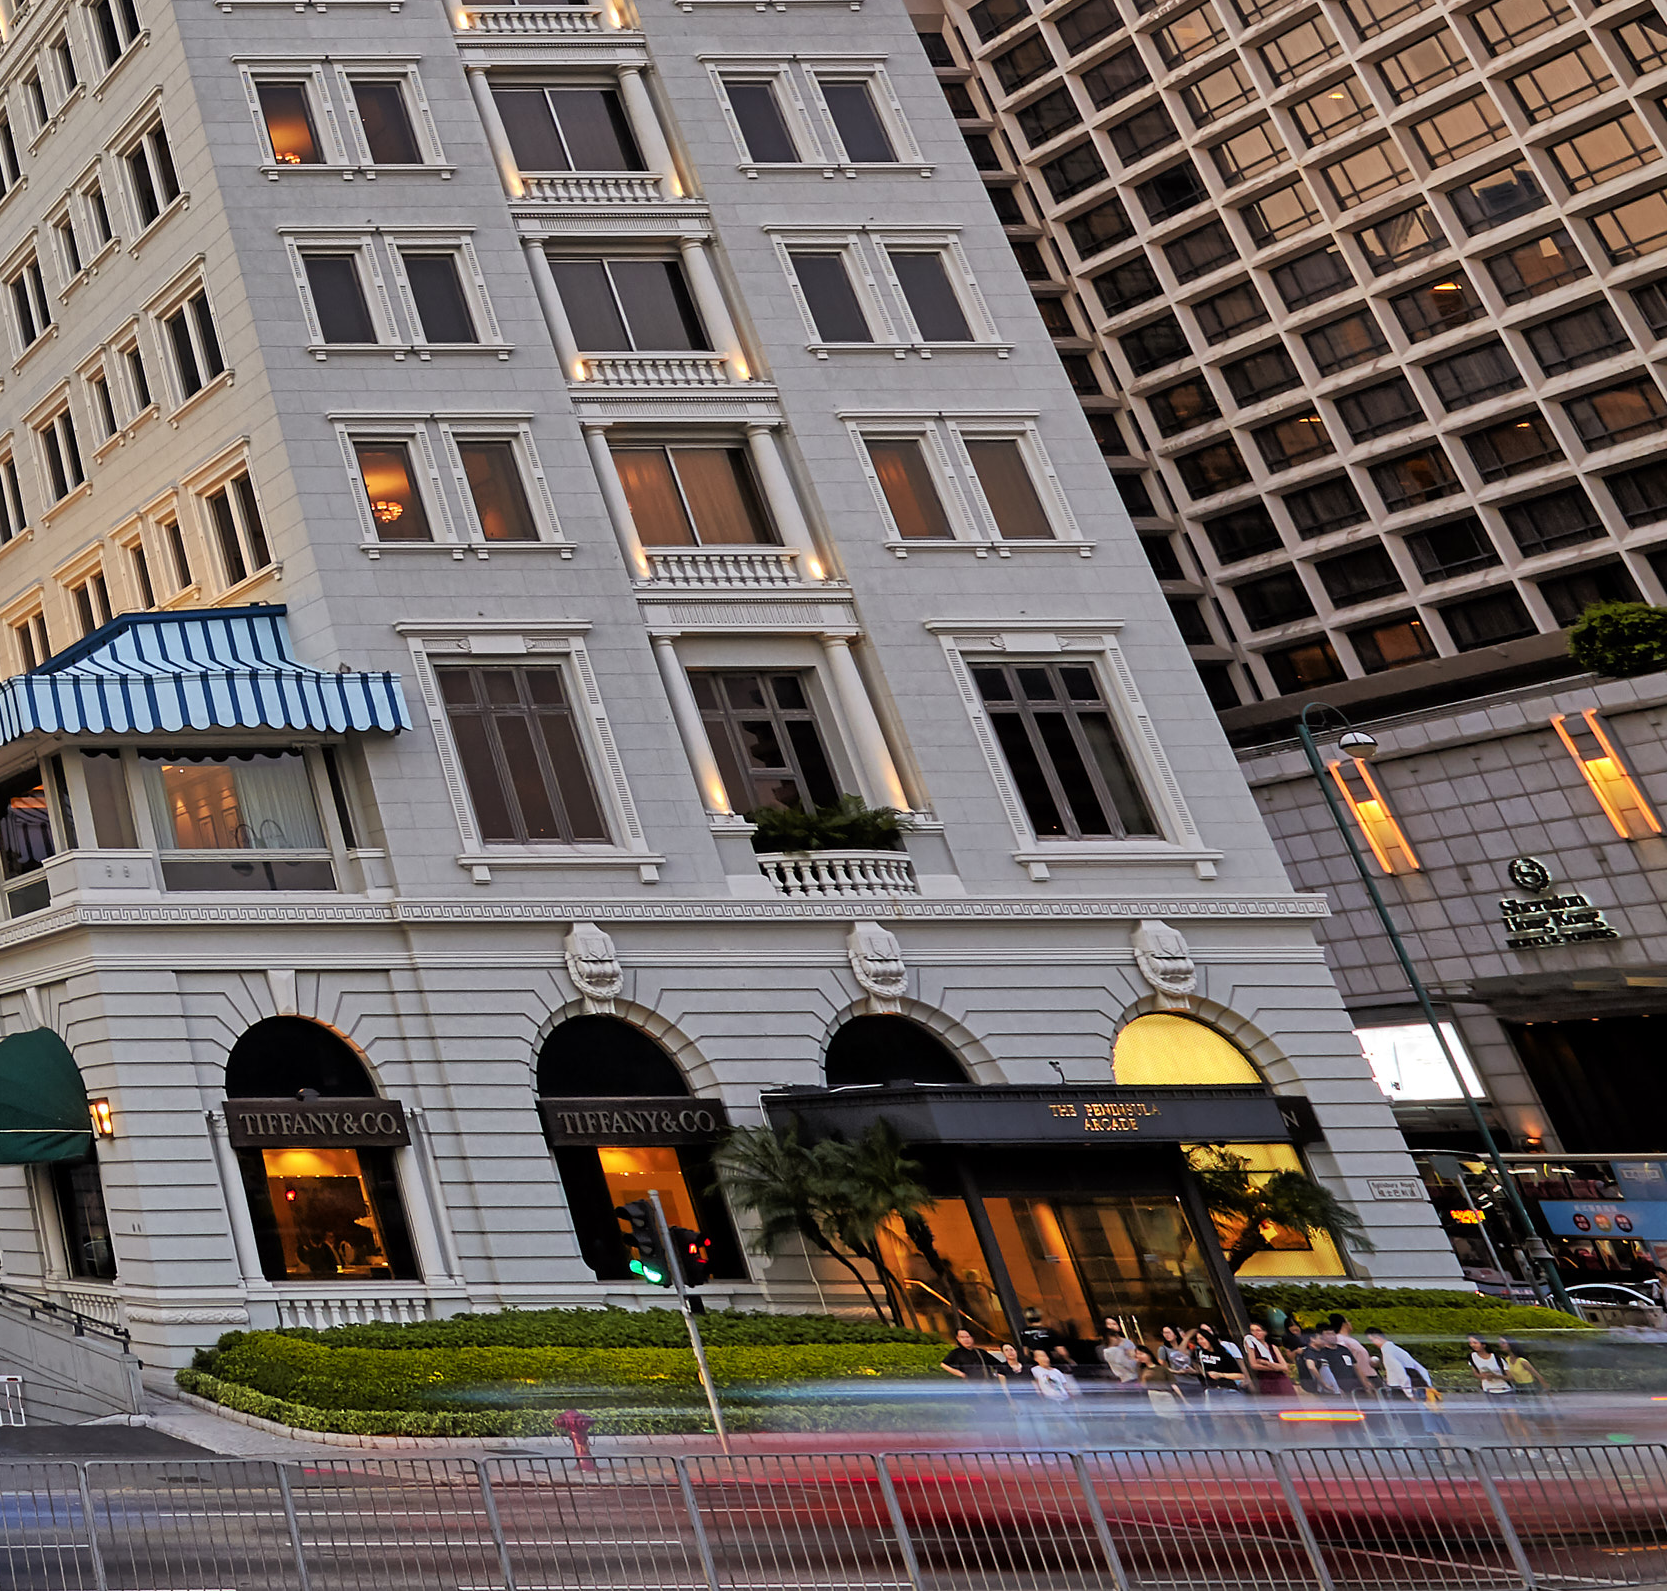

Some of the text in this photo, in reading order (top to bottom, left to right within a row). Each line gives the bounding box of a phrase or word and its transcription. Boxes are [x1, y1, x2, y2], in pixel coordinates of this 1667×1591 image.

[1499, 895, 1589, 916] Sheraton
[1502, 910, 1607, 934] Hong Kong
[1048, 1103, 1162, 1117] THE PENINSULA
[1084, 1118, 1139, 1131] ARCADE
